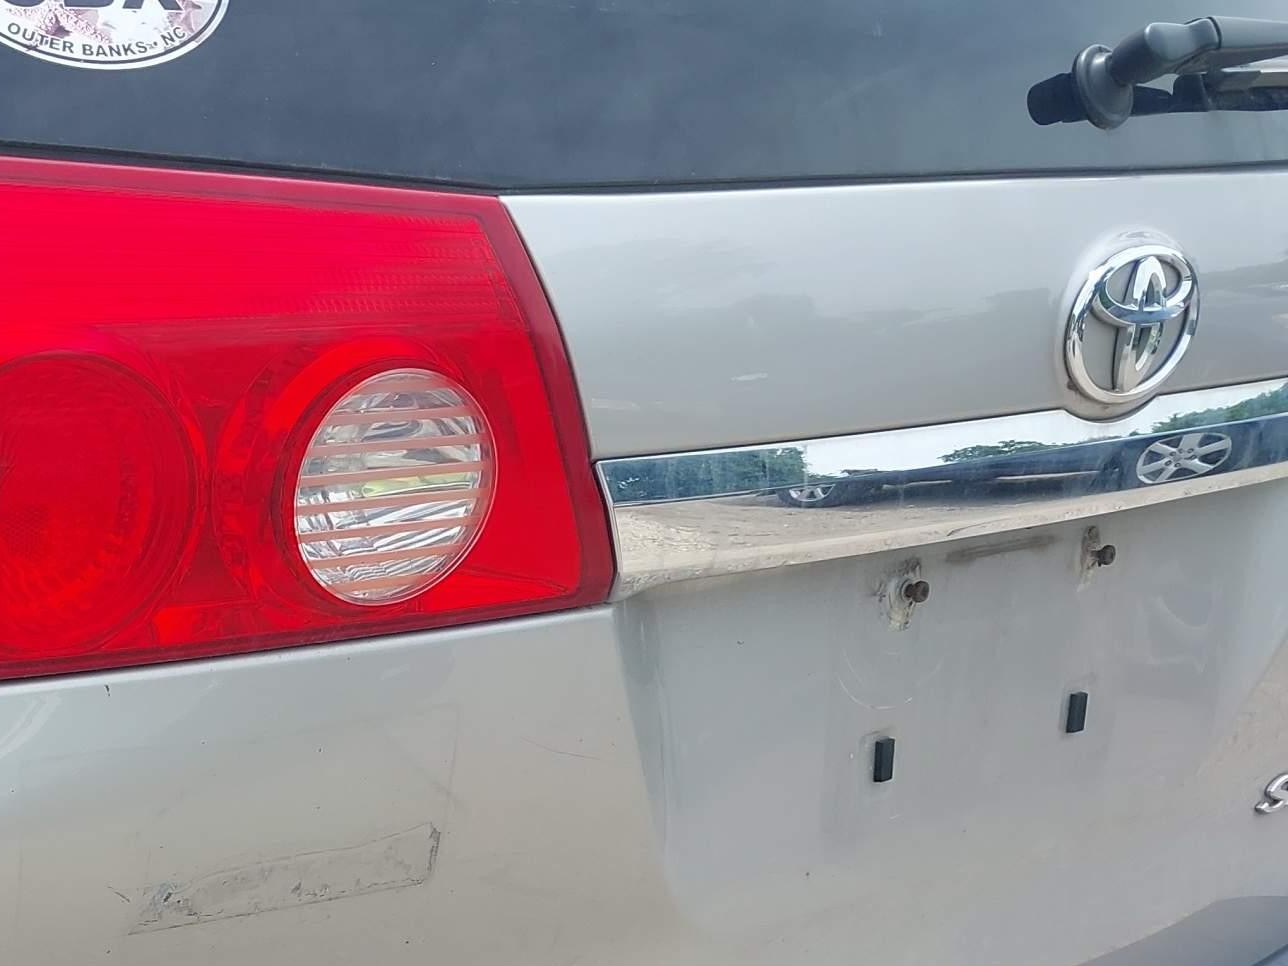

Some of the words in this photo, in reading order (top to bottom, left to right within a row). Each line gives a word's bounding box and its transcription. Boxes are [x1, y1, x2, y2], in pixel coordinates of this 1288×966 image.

[7, 22, 75, 53] OUTER
[82, 41, 147, 57] BANKS
[160, 26, 186, 46] NC
